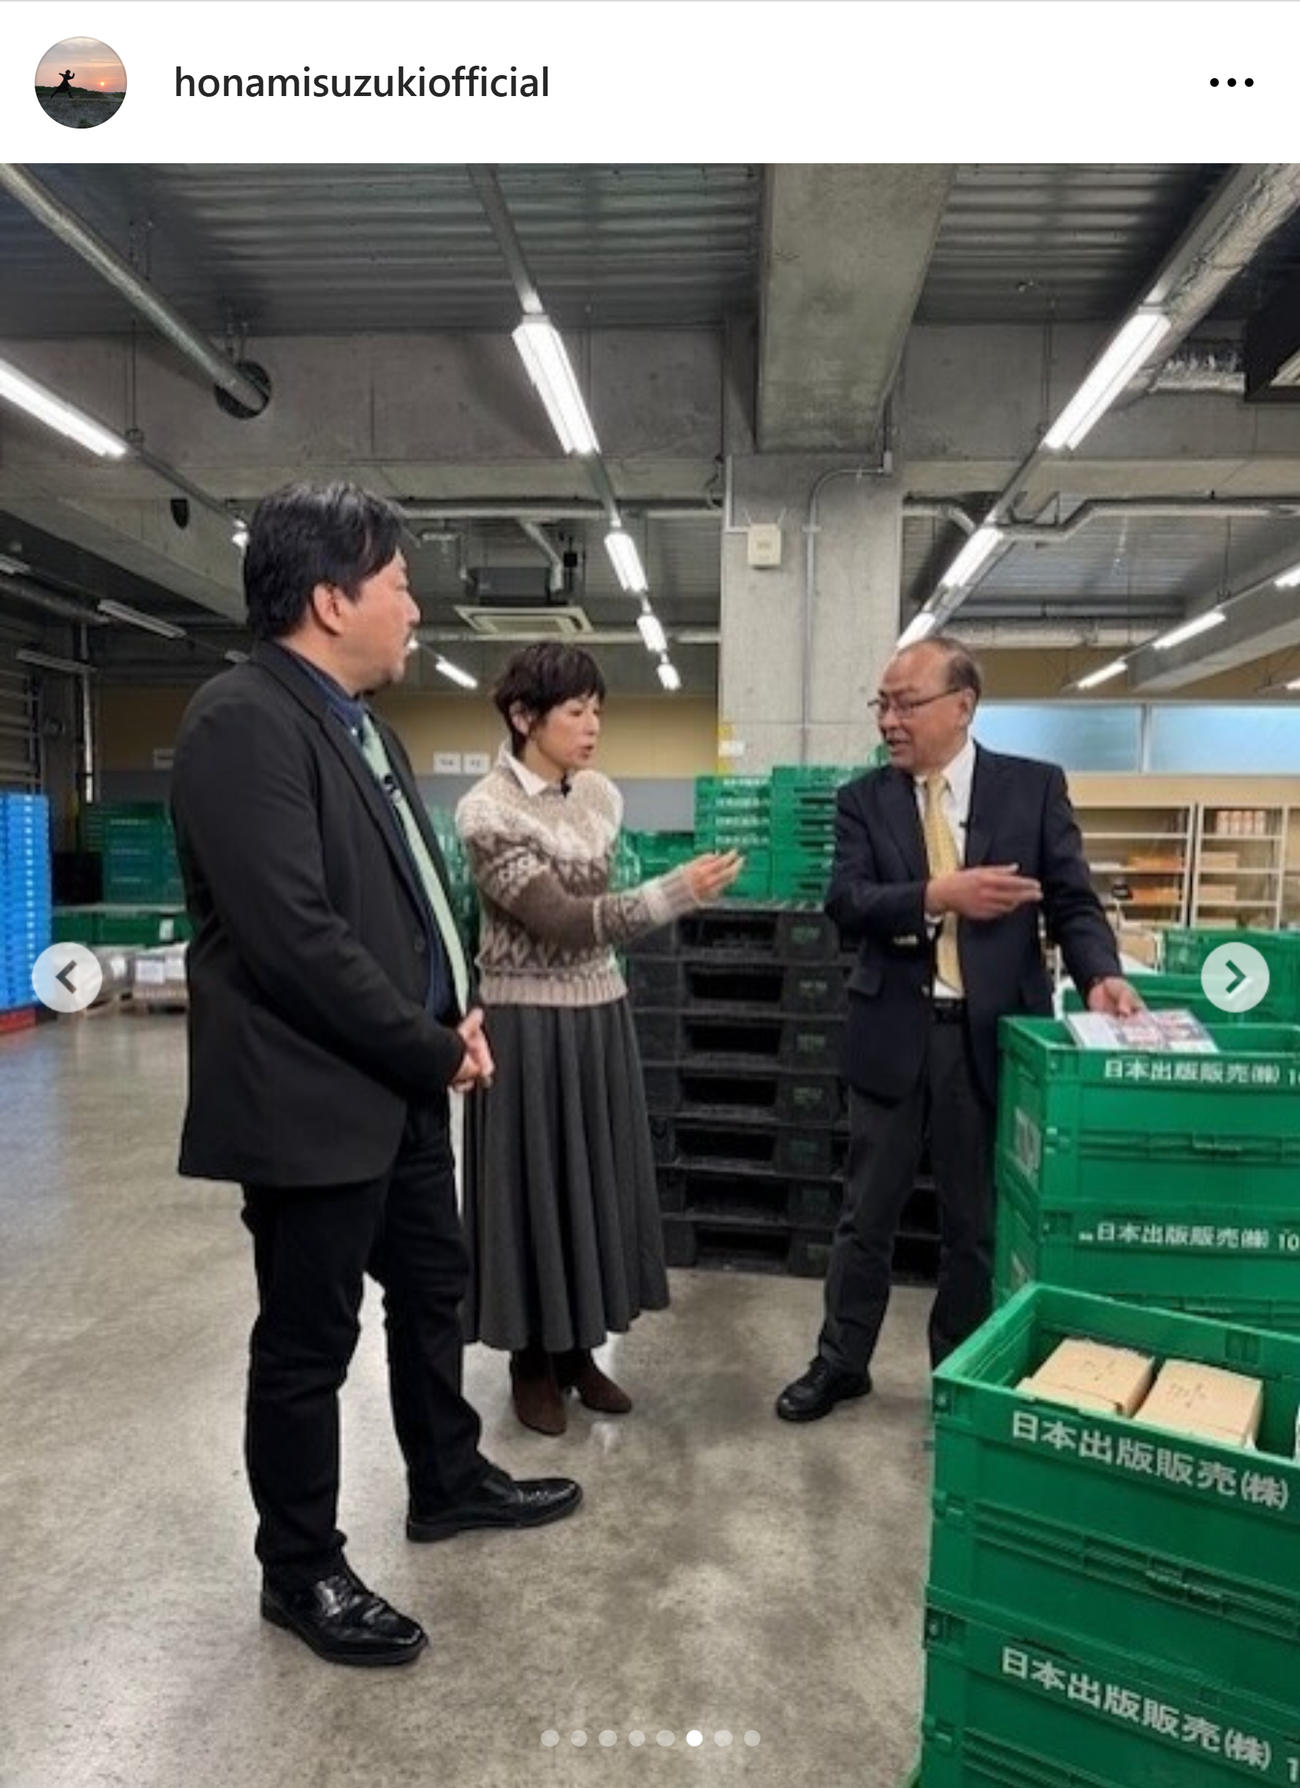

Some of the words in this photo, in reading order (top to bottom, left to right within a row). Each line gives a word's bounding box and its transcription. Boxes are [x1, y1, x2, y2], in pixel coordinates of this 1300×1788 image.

[1012, 1410, 1289, 1510] 日本出版販売(株)
[1002, 1647, 1273, 1772] 日本出版販売(株)
